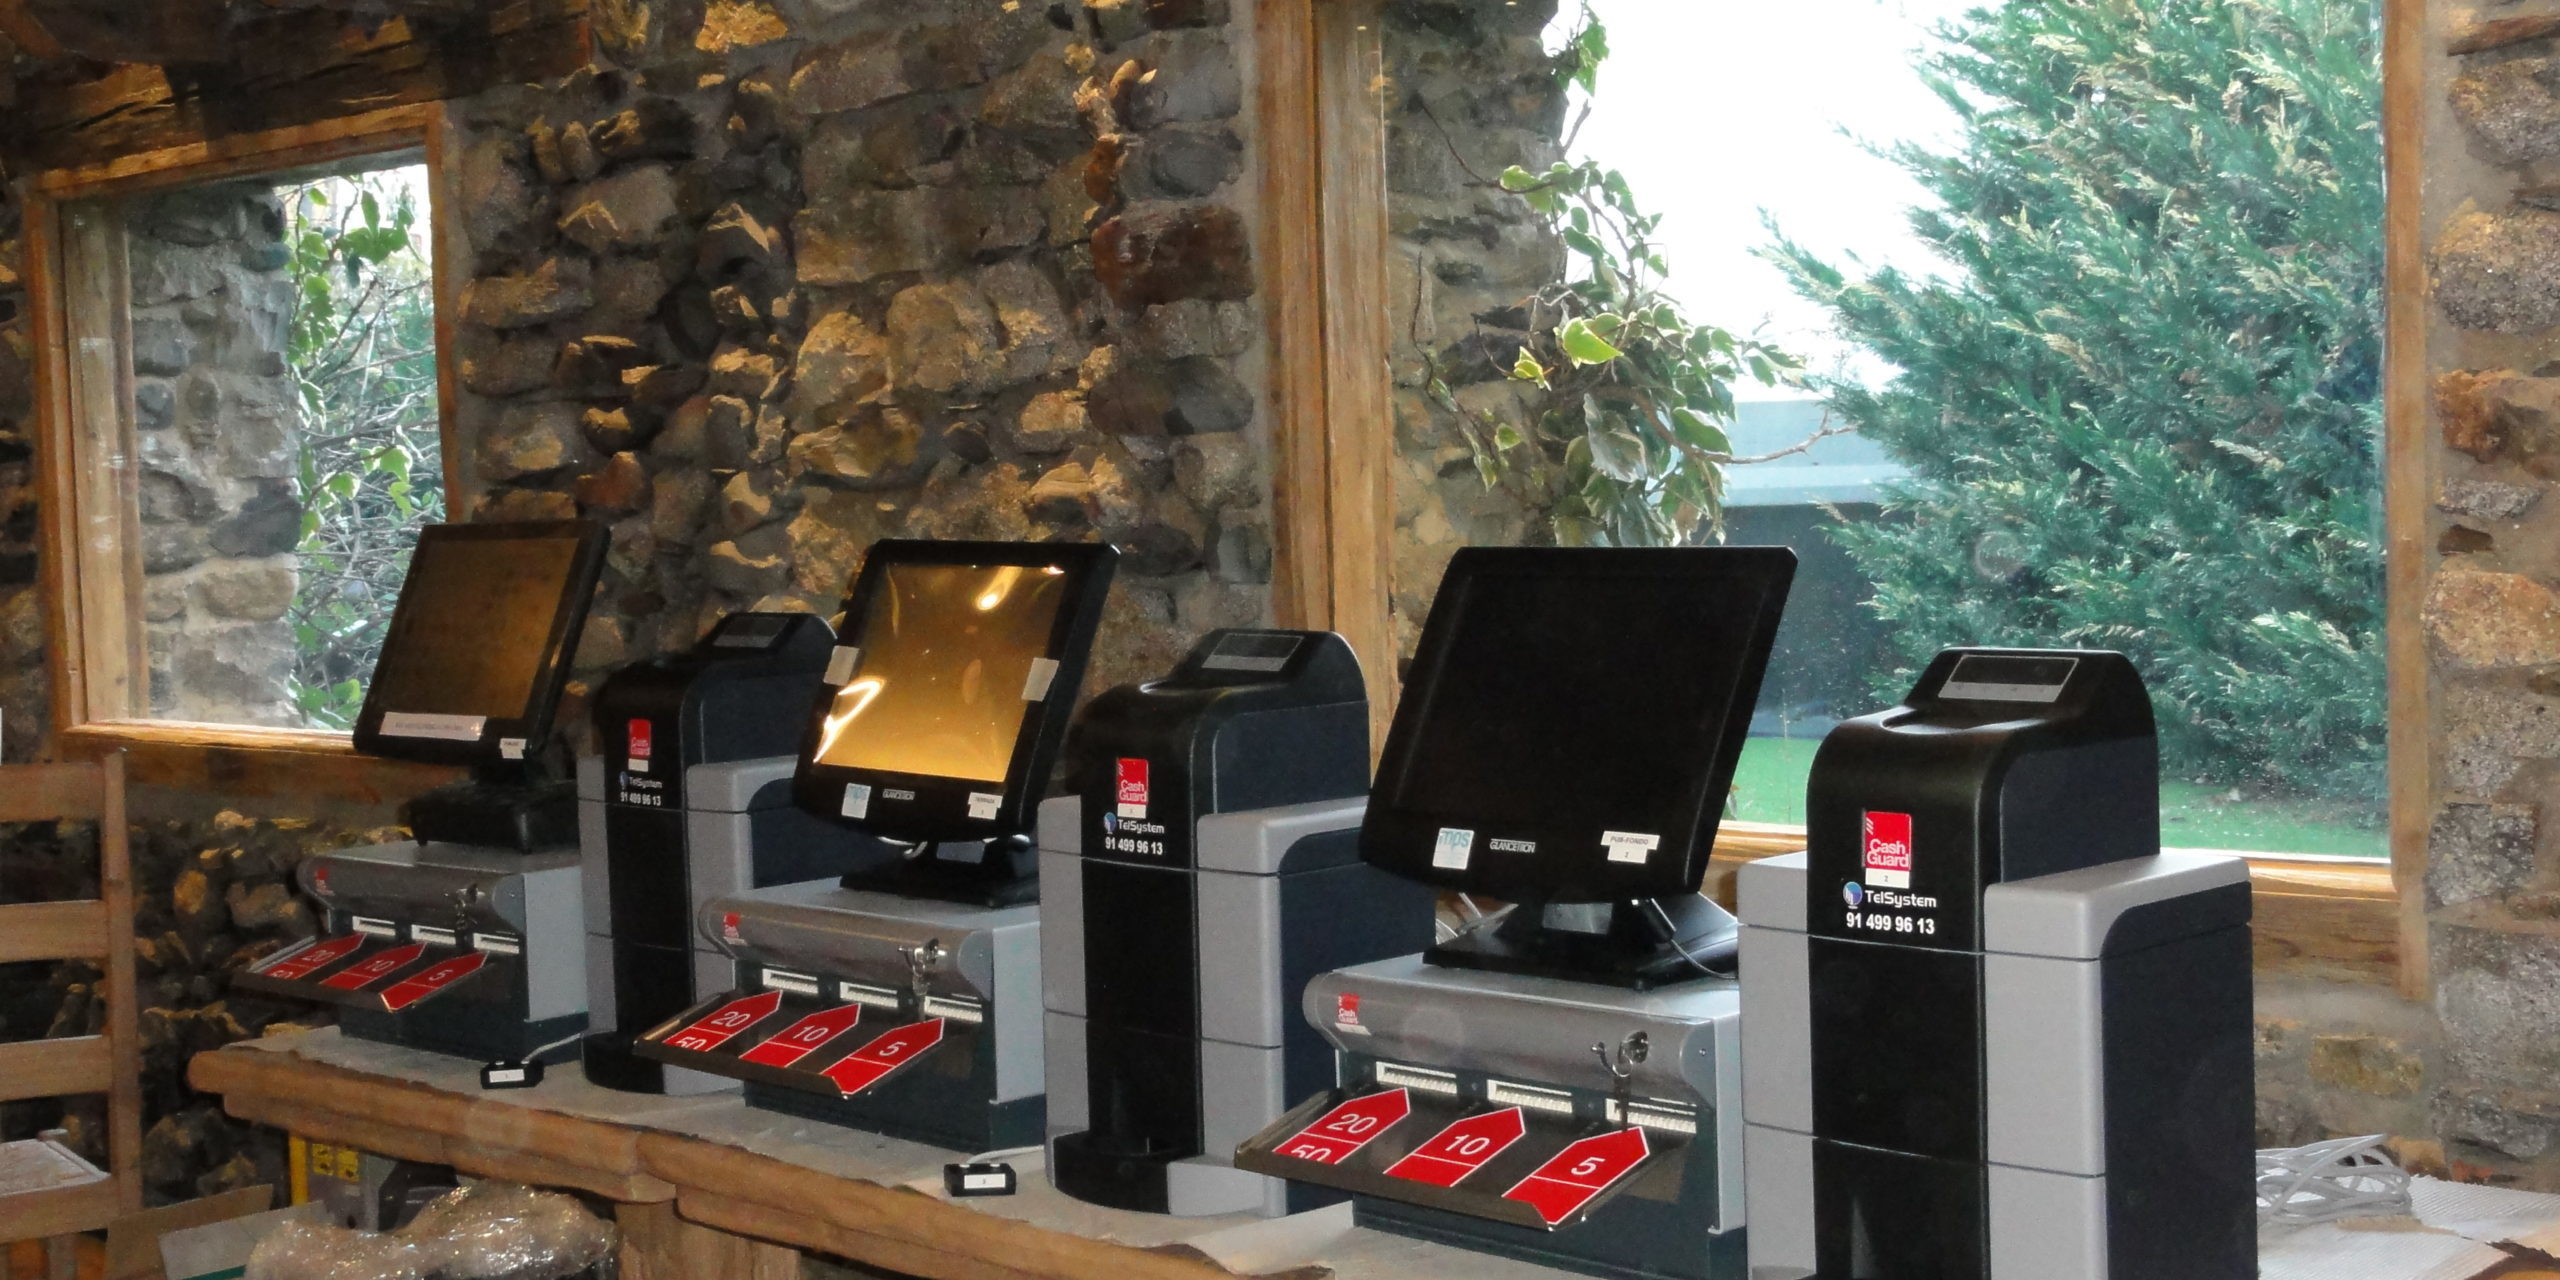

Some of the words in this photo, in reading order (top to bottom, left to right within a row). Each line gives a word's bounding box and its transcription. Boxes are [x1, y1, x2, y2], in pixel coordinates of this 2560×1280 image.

[1121, 780, 1145, 792] Cash
[1119, 789, 1147, 802] Guard
[1118, 819, 1165, 834] TelSystem
[1105, 837, 1116, 850] 91
[1118, 838, 1135, 852] 499
[1137, 840, 1149, 854] 96
[1151, 842, 1163, 855] 13
[1869, 838, 1906, 854] Cash
[1866, 851, 1910, 868] Guard
[1865, 890, 1937, 908] TelSystem
[1846, 912, 1861, 928] 91
[1865, 913, 1891, 931] 499
[1895, 916, 1913, 932] 96
[1917, 918, 1935, 935] 13
[365, 959, 395, 972] 10
[428, 969, 453, 981] 5
[710, 1011, 750, 1027] 20
[792, 1025, 829, 1042] 10
[879, 1041, 907, 1056] 5
[1326, 1113, 1378, 1134] 20
[1291, 1144, 1332, 1162] 50
[1445, 1134, 1490, 1156] 10
[1570, 1156, 1606, 1176] 5
